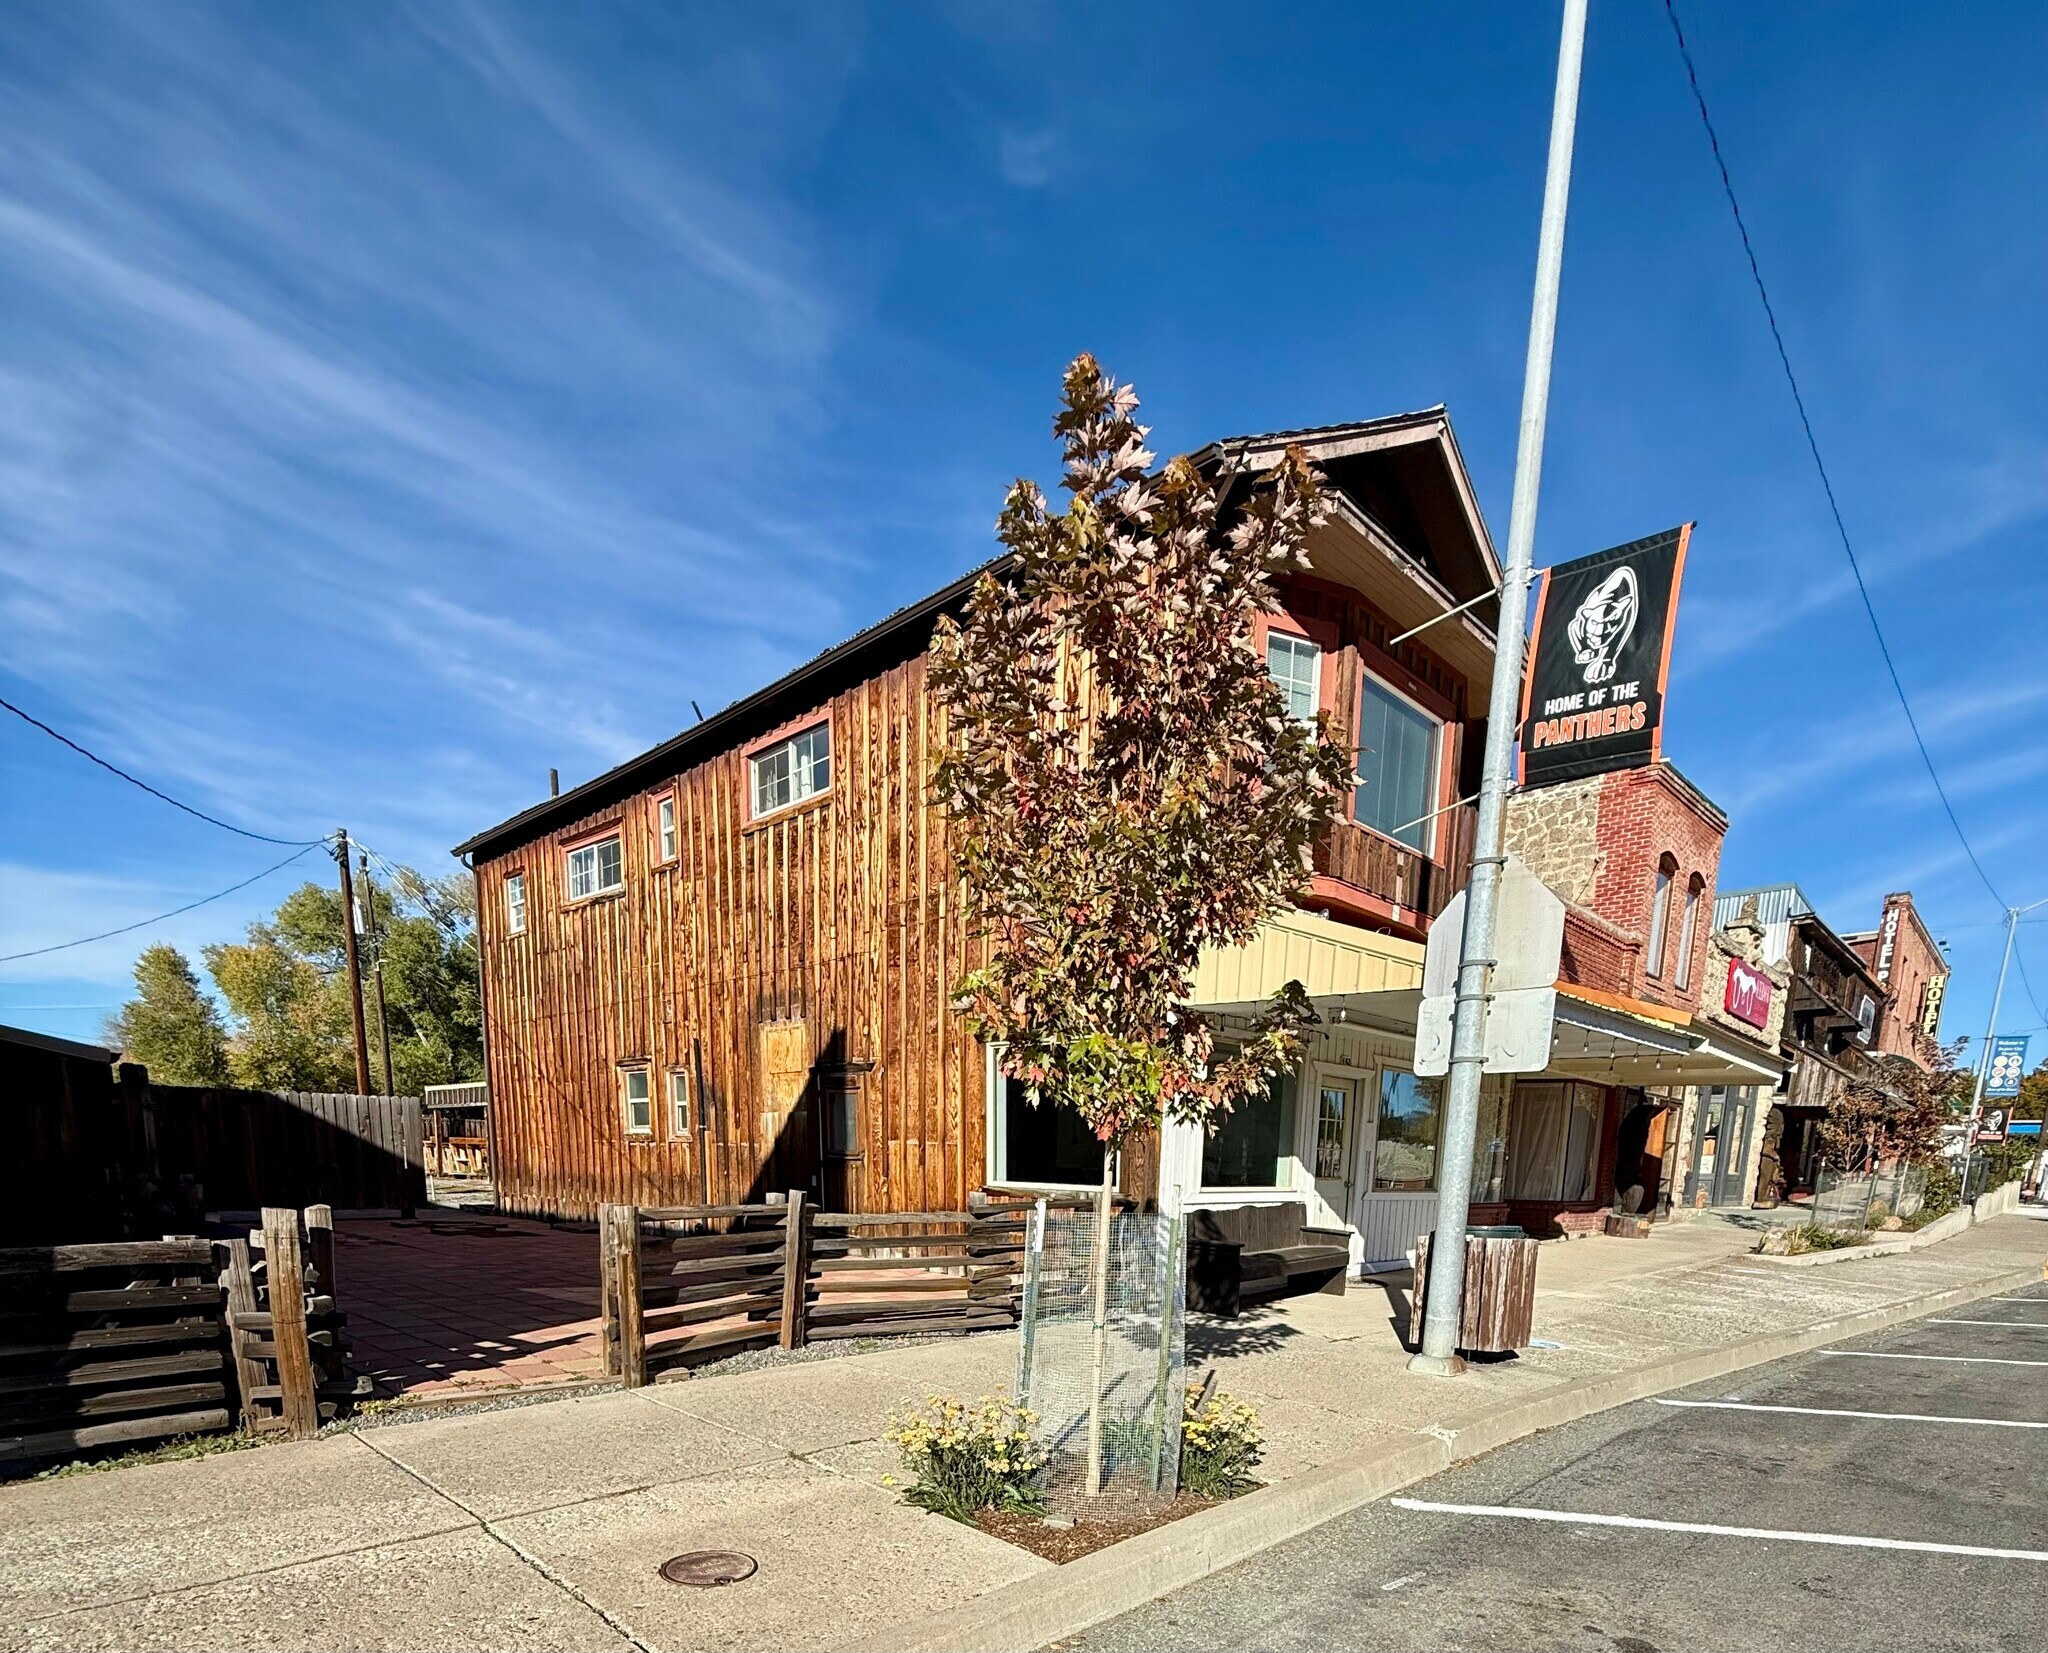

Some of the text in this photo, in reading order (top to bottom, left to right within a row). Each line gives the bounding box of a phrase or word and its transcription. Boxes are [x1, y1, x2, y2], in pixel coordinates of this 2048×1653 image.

[1533, 701, 1647, 749] PANTHERS
[1544, 680, 1640, 716] HOME OF THE
[1878, 908, 1900, 968] HOTEL
[1923, 975, 1946, 1037] HOTEL
